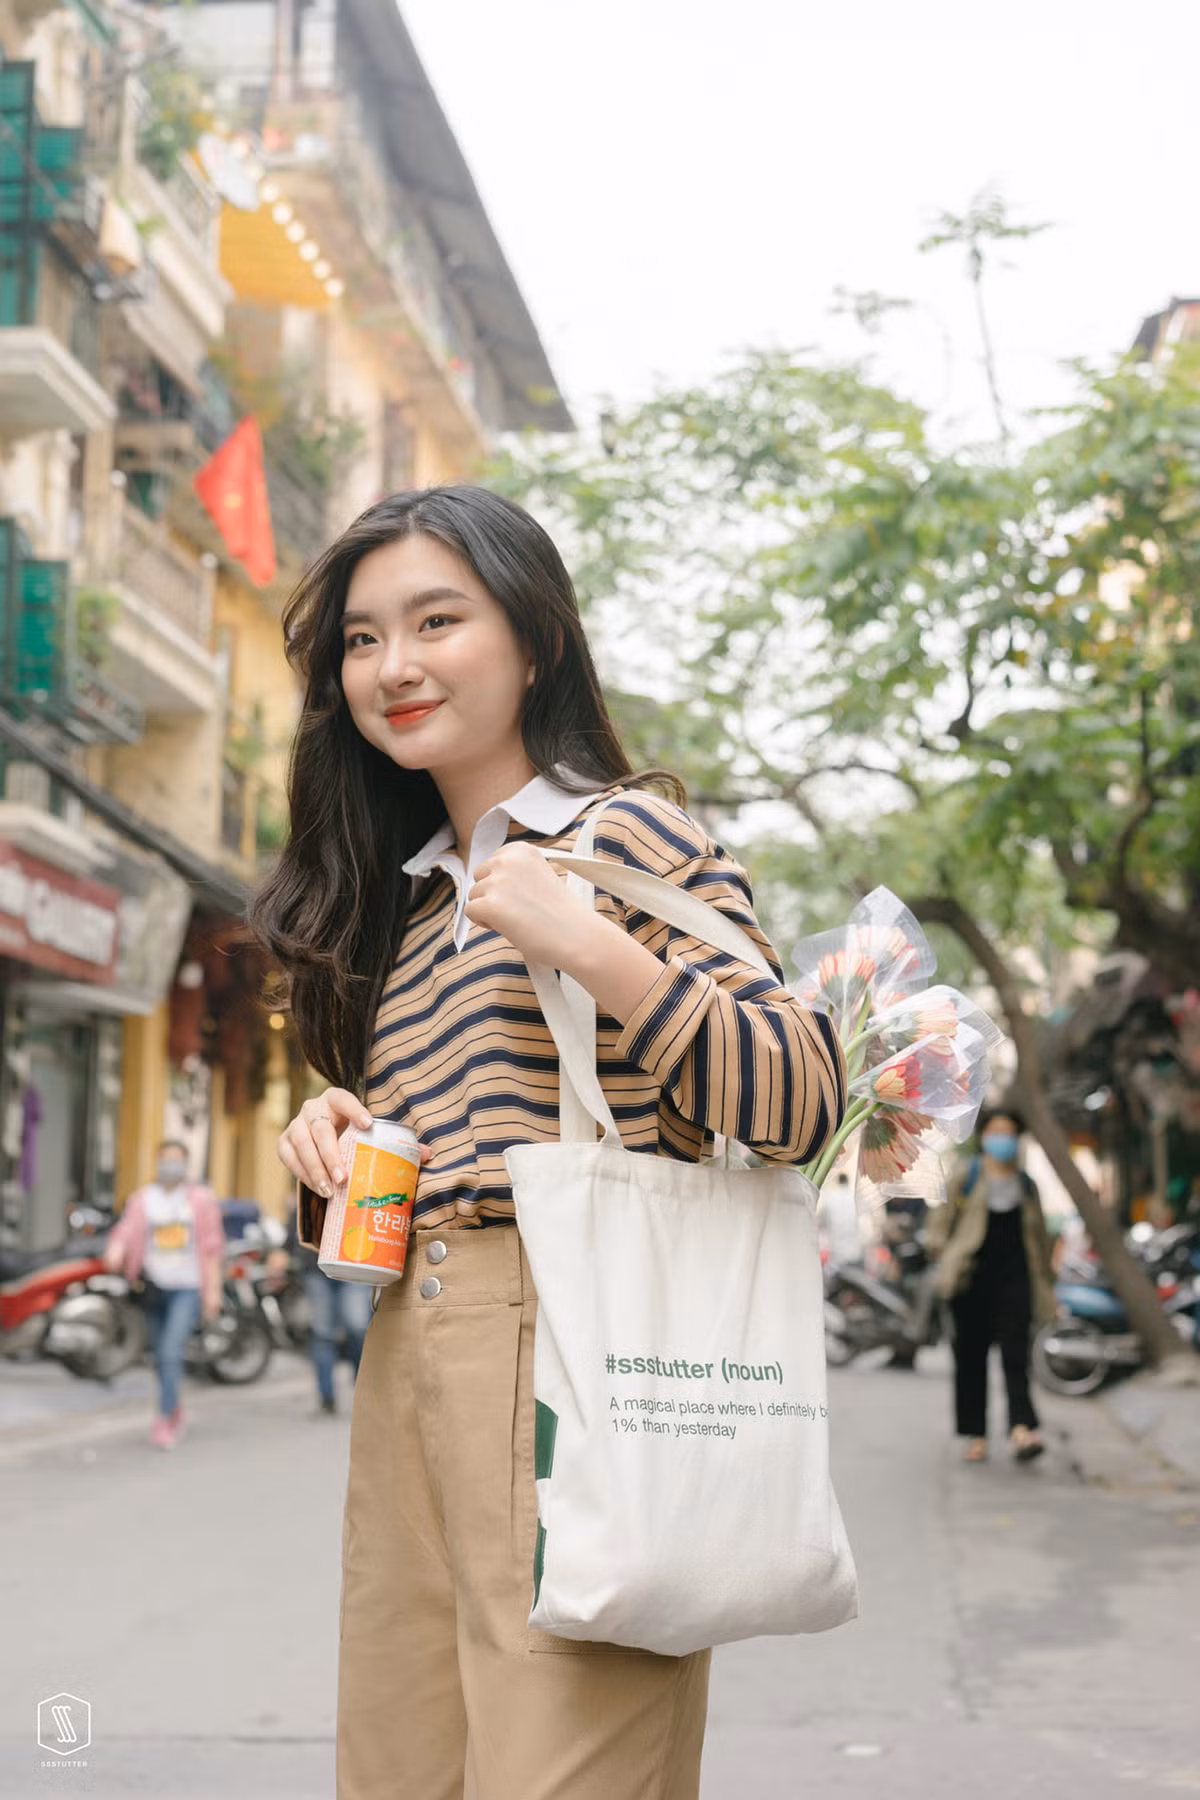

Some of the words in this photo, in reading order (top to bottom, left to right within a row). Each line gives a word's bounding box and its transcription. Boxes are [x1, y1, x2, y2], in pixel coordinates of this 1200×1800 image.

[606, 1353, 714, 1379] #ssstutter
[721, 1358, 783, 1385] (noun)
[609, 1397, 620, 1411] A
[624, 1398, 676, 1414] magical
[679, 1401, 715, 1416] place
[718, 1401, 756, 1416] where
[759, 1403, 763, 1416] I
[767, 1402, 816, 1421] definitely
[612, 1418, 637, 1433] 1%
[642, 1418, 670, 1434] than
[673, 1421, 737, 1439] yesterday
